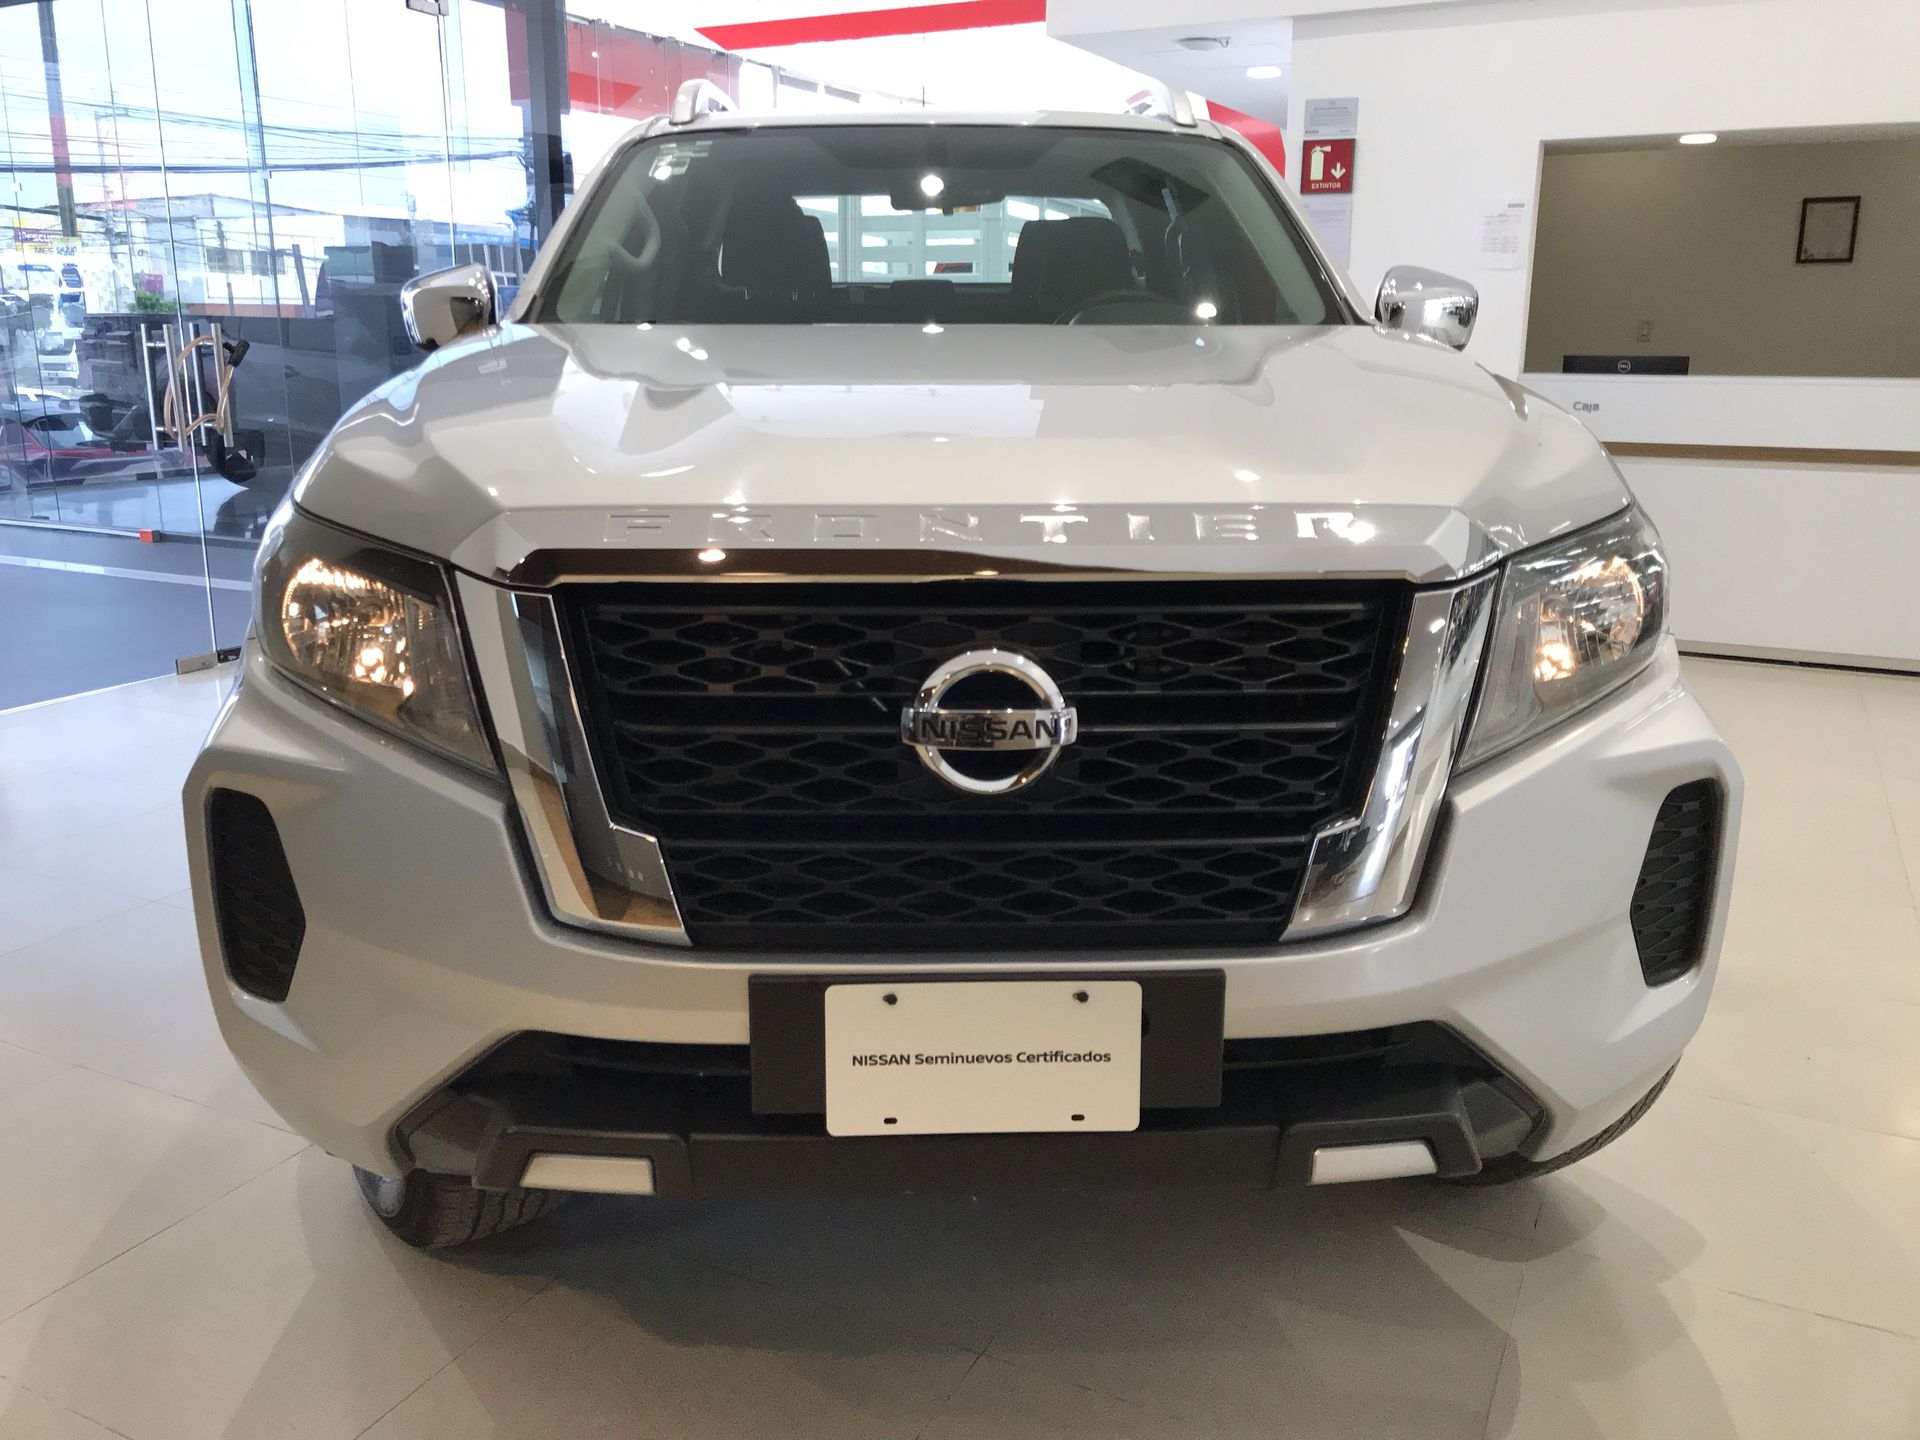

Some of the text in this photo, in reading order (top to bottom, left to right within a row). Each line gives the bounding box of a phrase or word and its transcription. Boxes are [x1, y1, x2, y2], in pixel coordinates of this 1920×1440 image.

[1311, 182, 1342, 190] EXTINTOR
[1573, 401, 1600, 414] Caja
[603, 511, 1374, 543] FRONTIER
[921, 718, 1060, 742] NISSAN
[851, 1050, 1112, 1067] NISSAN Seminuevos Certificados
